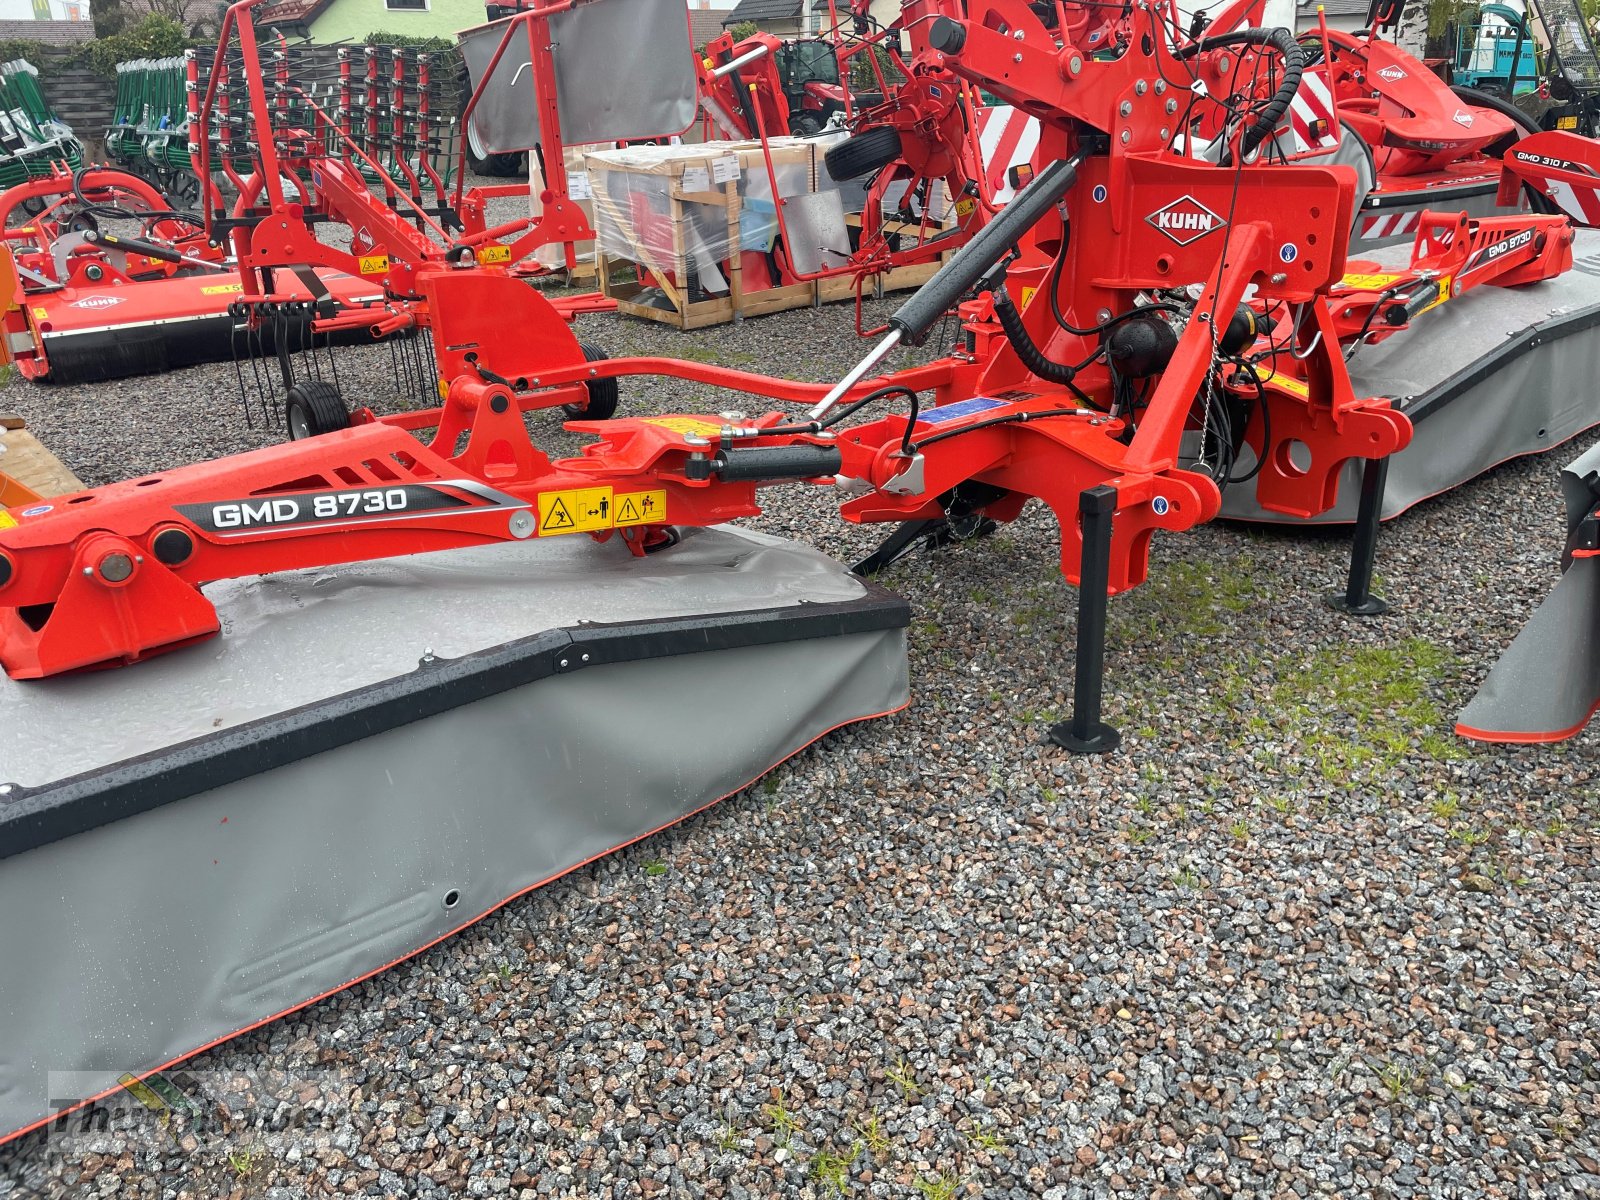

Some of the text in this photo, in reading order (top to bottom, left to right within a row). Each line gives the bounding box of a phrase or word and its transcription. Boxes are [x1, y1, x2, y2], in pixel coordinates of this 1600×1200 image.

[1381, 69, 1403, 78] KUHN
[1517, 152, 1540, 163] GMD
[1542, 157, 1560, 167] 310
[1159, 212, 1212, 230] KUHN
[1489, 230, 1531, 258] GMD 8730
[79, 298, 118, 308] KUHN
[213, 490, 407, 527] GMD 8730
